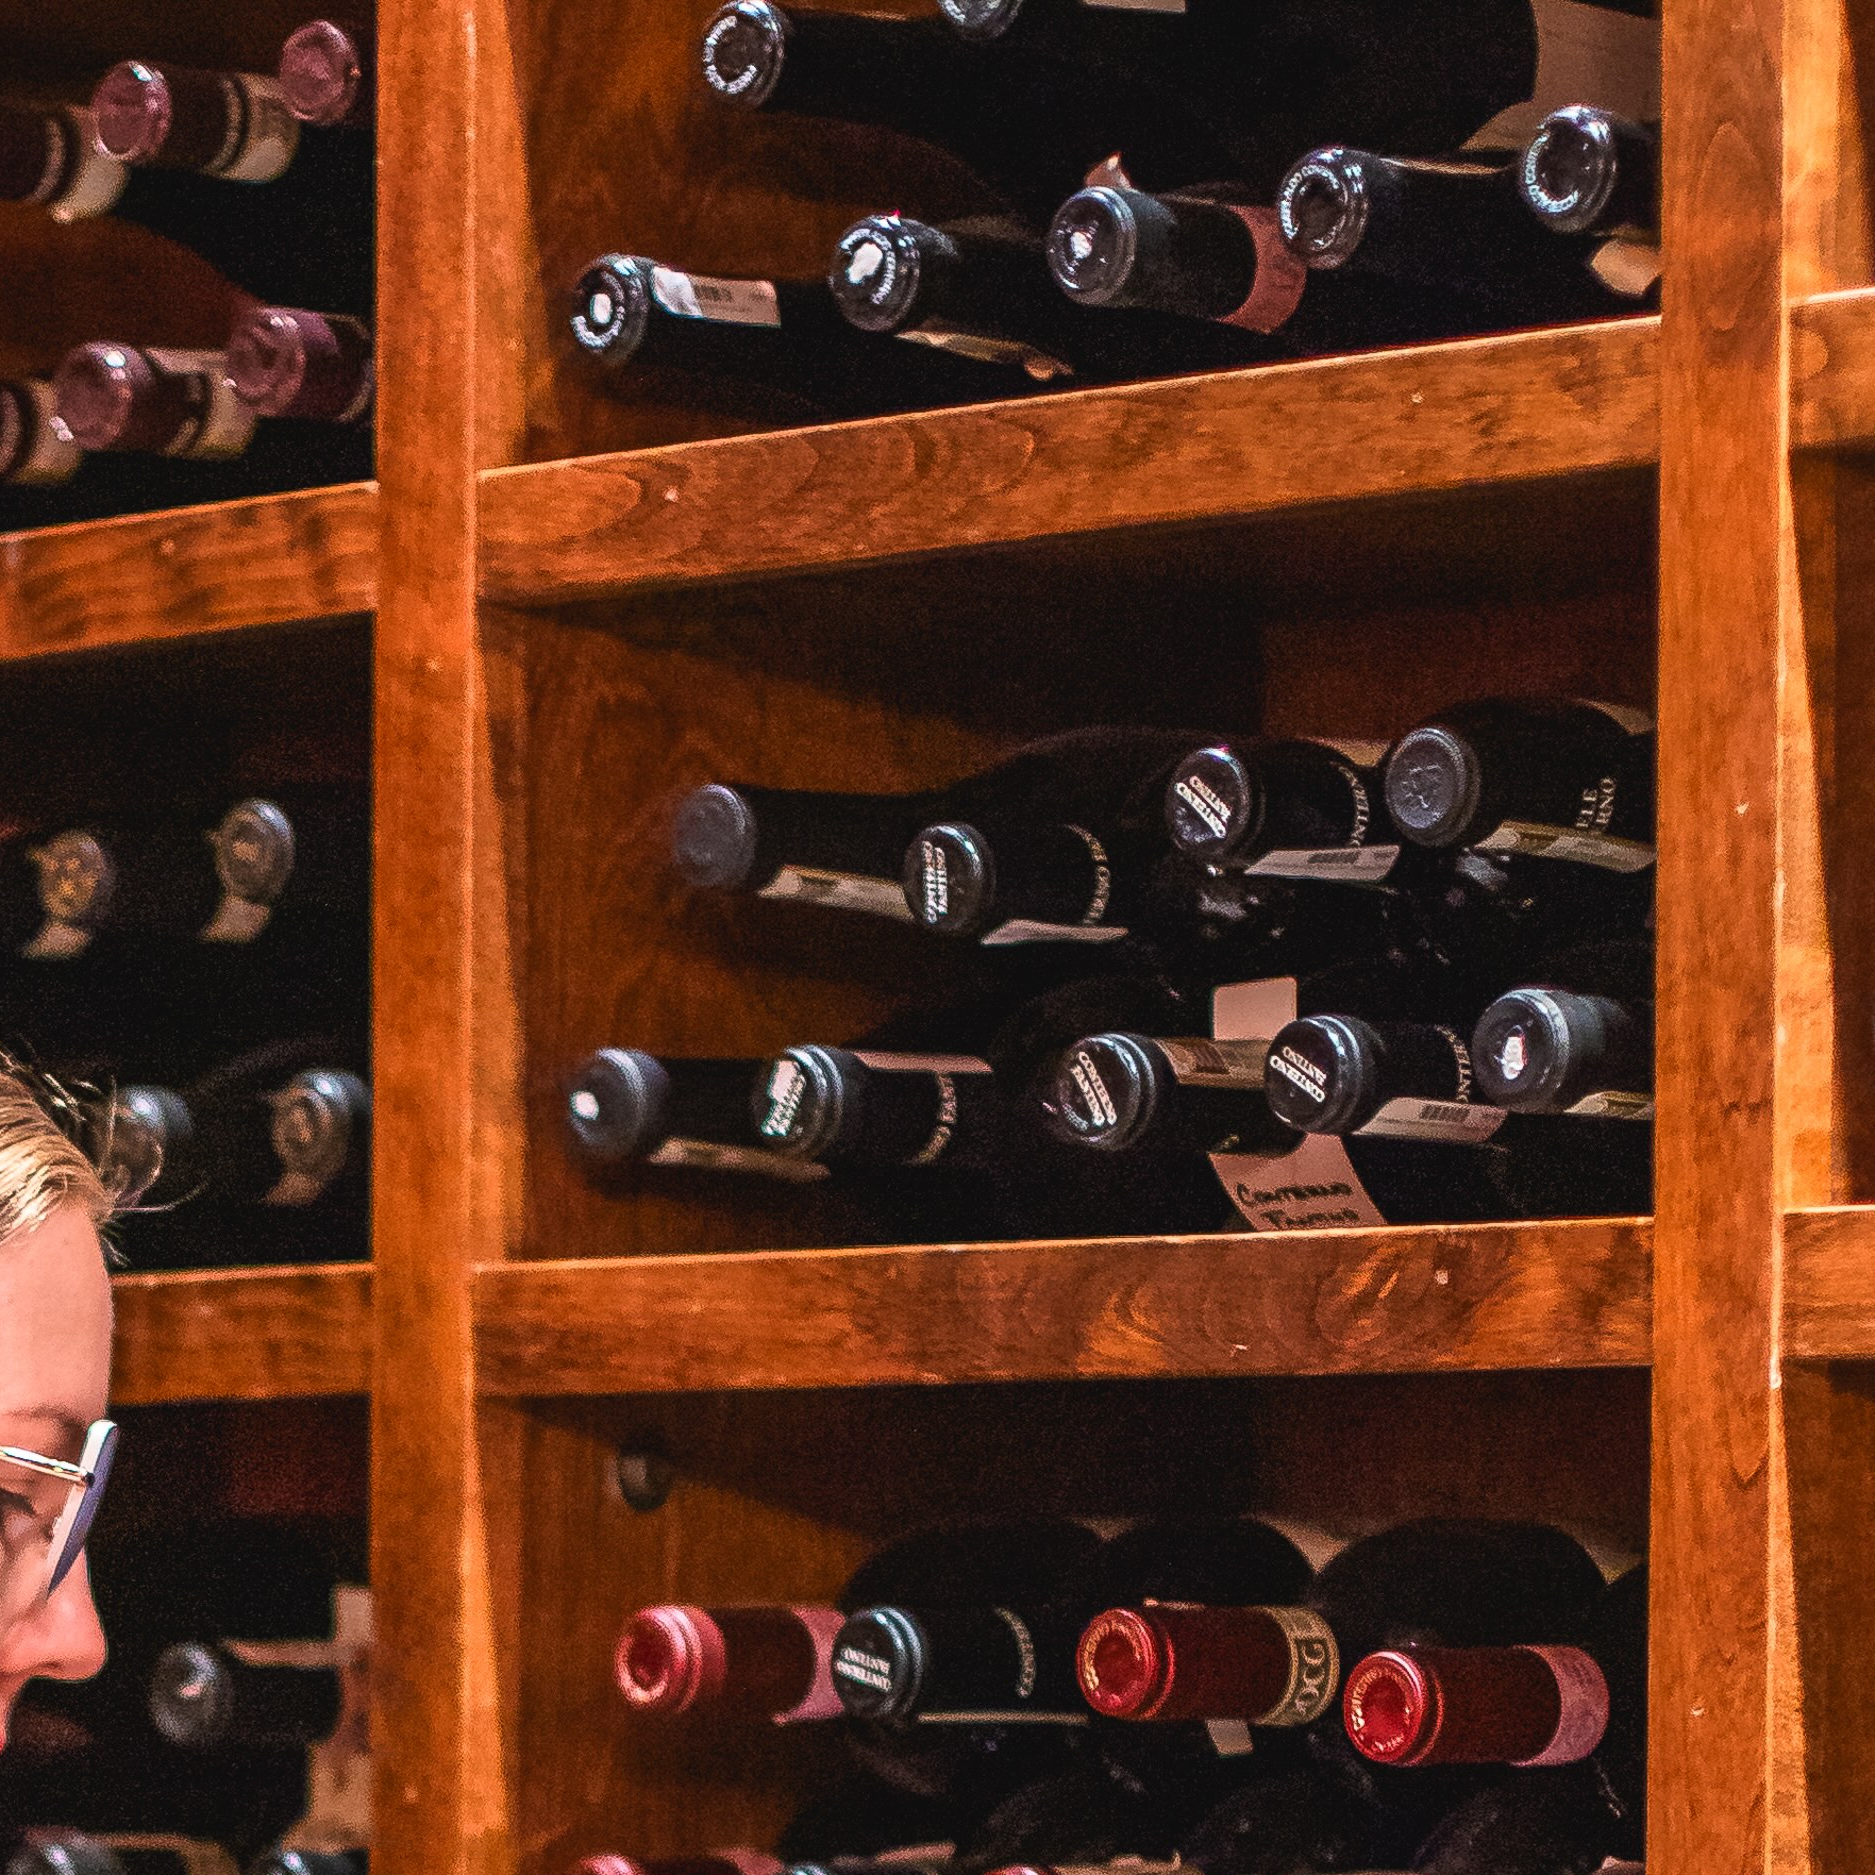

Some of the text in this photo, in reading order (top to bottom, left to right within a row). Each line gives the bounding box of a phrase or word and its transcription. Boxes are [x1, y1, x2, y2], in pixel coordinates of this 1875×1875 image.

[1175, 782, 1227, 838] CONTERNO
[1269, 1055, 1326, 1103] CONTERNO
[1281, 1045, 1327, 1086] FANTINO
